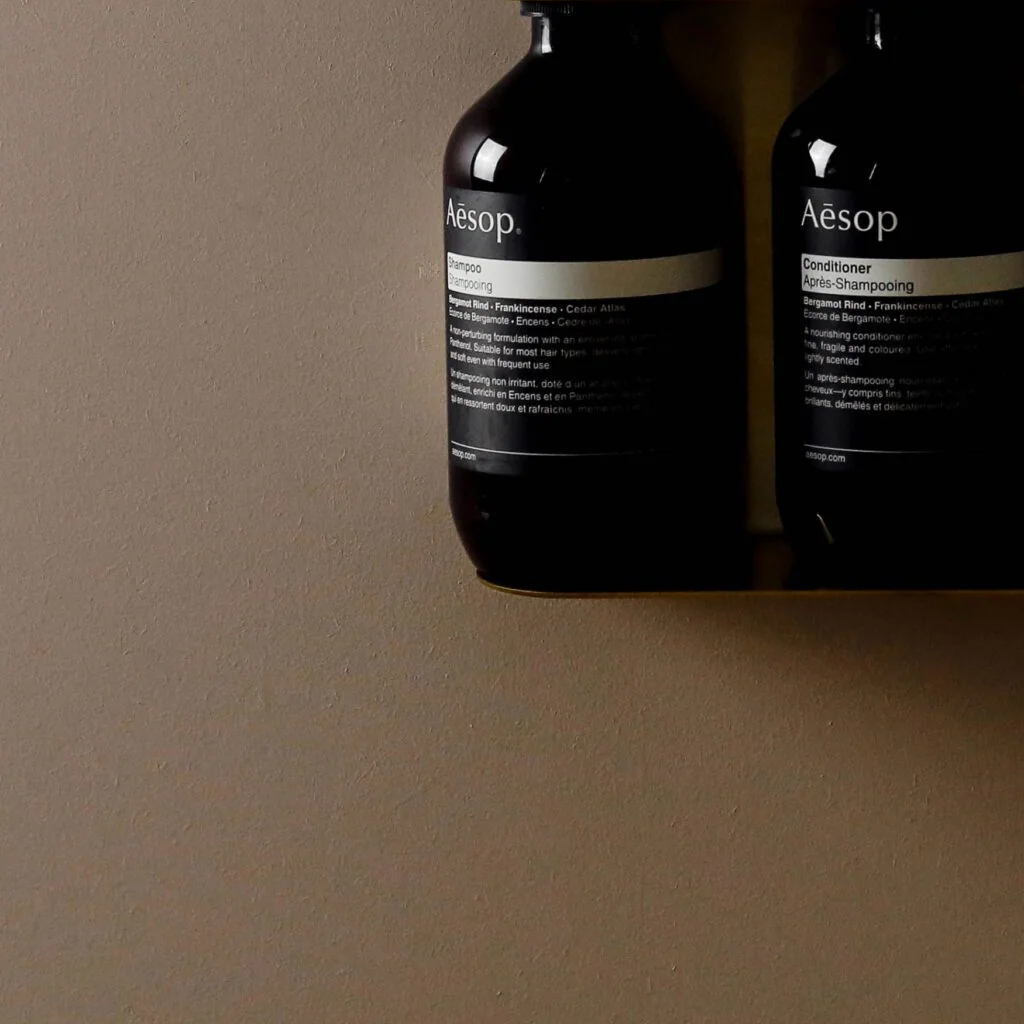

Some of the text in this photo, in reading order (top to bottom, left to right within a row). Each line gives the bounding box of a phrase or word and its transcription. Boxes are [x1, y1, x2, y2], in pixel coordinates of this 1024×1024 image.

[449, 256, 482, 275] Shampoo
[803, 258, 873, 274] Conditioner
[449, 272, 493, 294] Shampooing
[803, 275, 915, 295] Après-Shampooing
[472, 299, 490, 311] Rind
[495, 302, 557, 314] Frankincense
[566, 304, 598, 314] Cedar
[803, 296, 842, 309] Bergamot
[844, 300, 867, 310] Rind
[874, 301, 943, 312] Frankincense
[471, 312, 510, 325] Bergamote
[516, 316, 550, 326] Encens
[829, 312, 841, 322] de
[841, 312, 892, 326] Bergamote
[493, 332, 539, 344] formulation
[541, 334, 560, 344] with
[563, 336, 577, 344] an
[810, 328, 851, 342] nourishing
[852, 332, 905, 342] conditioner
[473, 342, 501, 355] Suitable
[503, 346, 514, 356] for
[516, 346, 538, 357] most
[540, 347, 558, 357] hair
[820, 341, 846, 354] fragile
[848, 344, 866, 353] and
[467, 356, 481, 365] even
[482, 357, 496, 367] with
[497, 358, 531, 371] frequent
[491, 377, 507, 387] non
[804, 370, 815, 381] Un
[816, 372, 895, 388] après-shampooing
[473, 387, 496, 398] enrichi
[497, 390, 507, 400] en
[508, 390, 542, 401] Encens
[543, 392, 553, 402] et
[554, 392, 567, 402] en
[848, 388, 884, 400] compris
[464, 398, 496, 410] ressortent
[496, 402, 516, 413] doux
[517, 403, 527, 414] et
[872, 402, 882, 411] et
[805, 451, 847, 464] aesop.com
